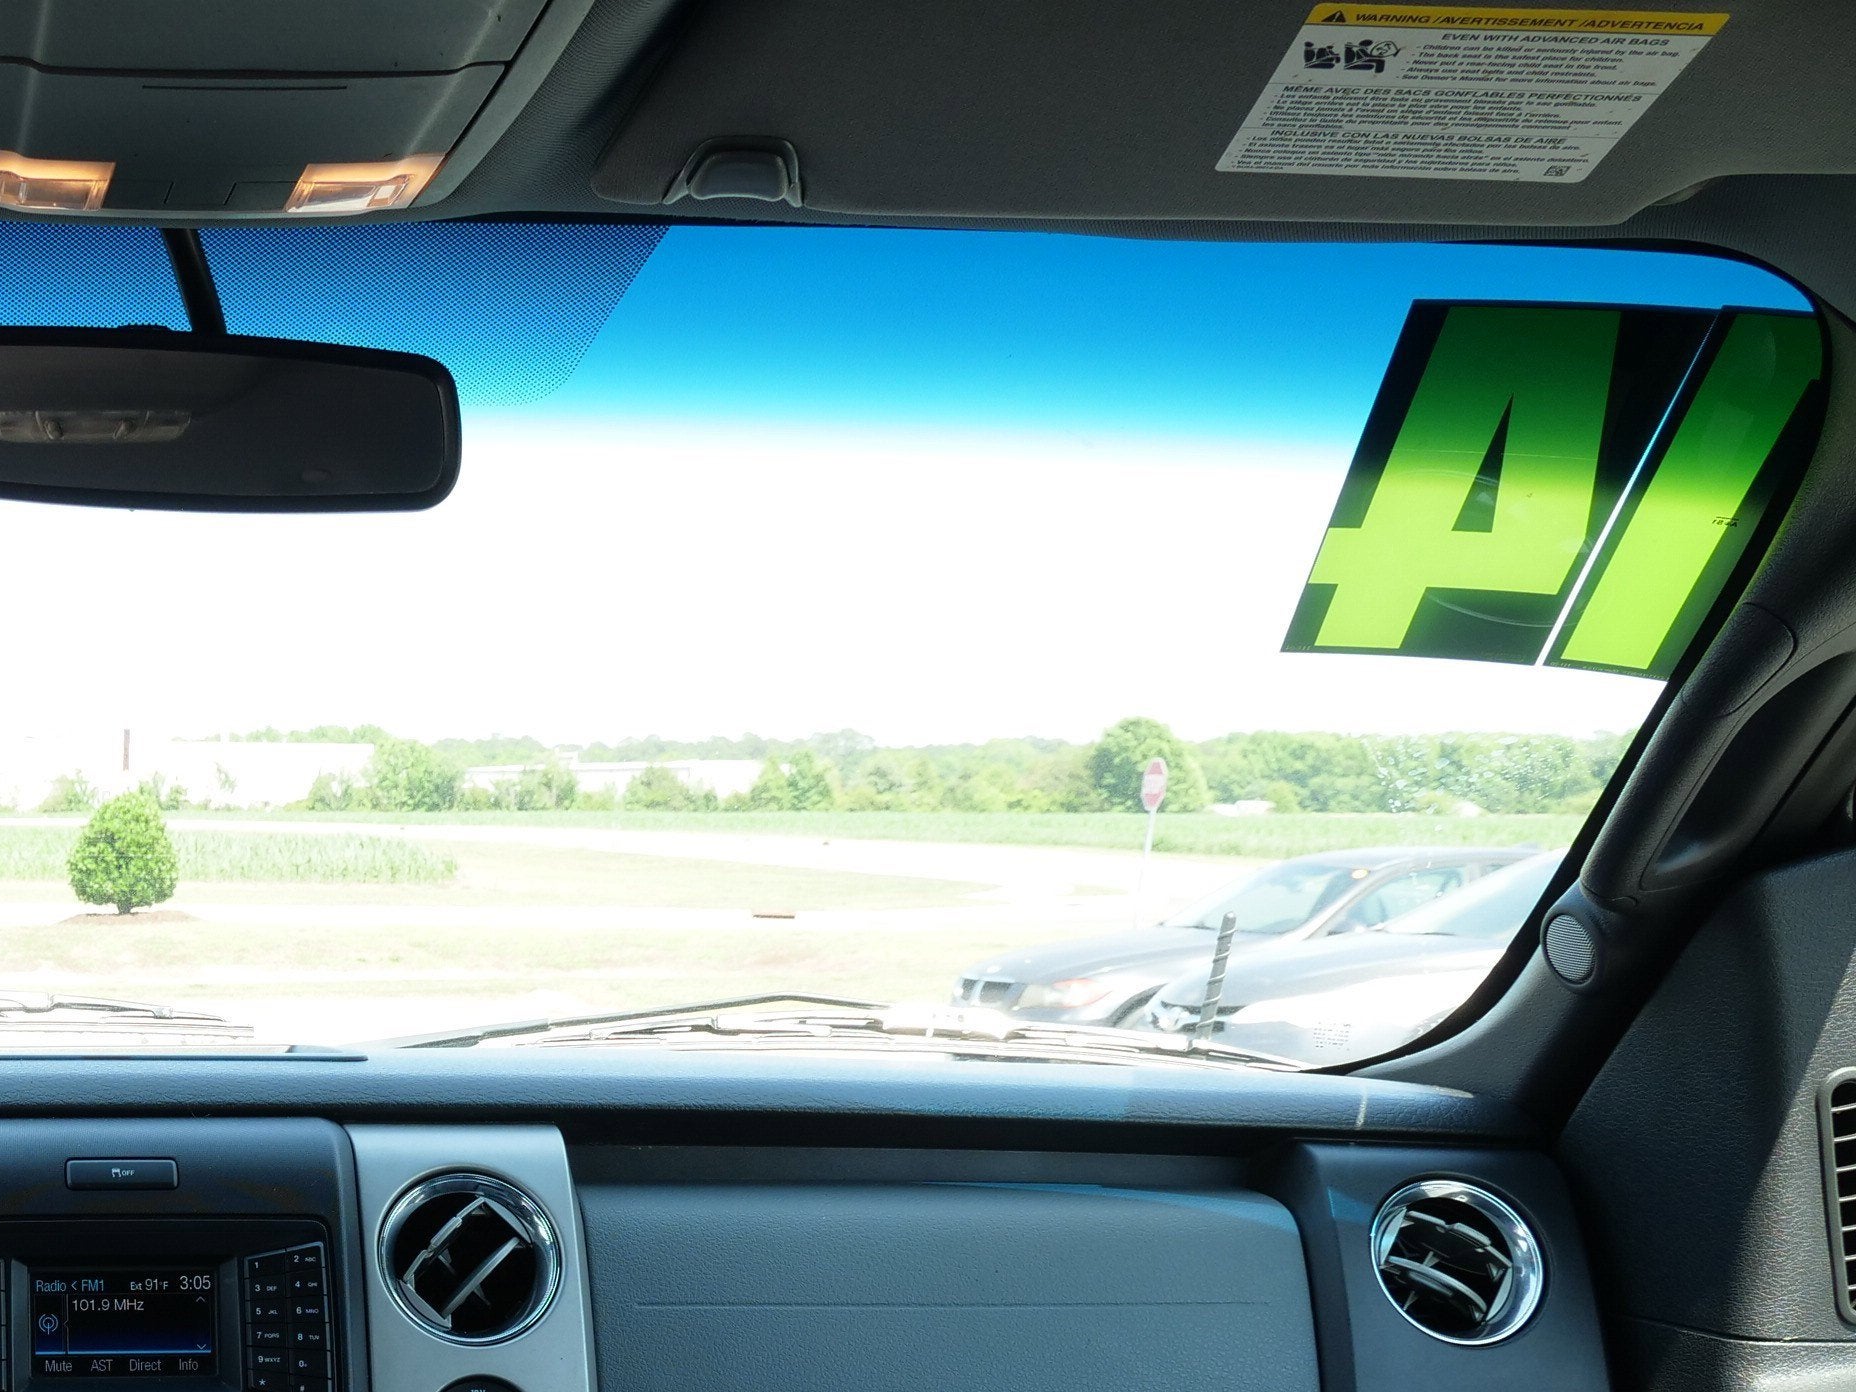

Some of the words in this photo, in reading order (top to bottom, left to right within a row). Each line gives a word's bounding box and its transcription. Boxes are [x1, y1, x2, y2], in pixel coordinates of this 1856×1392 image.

[1355, 14, 1430, 23] WARNING
[293, 1255, 299, 1263] 2
[36, 1279, 67, 1292] Radio
[81, 1279, 104, 1292] FM1
[130, 1281, 142, 1291] Ext
[179, 1275, 211, 1290] 3:05
[255, 1284, 261, 1292] 3
[72, 1299, 110, 1311] 101.9
[113, 1299, 144, 1311] MHz
[296, 1306, 302, 1314] 6
[256, 1307, 261, 1315] 5
[297, 1333, 303, 1341] 8
[258, 1355, 263, 1363] 9
[45, 1359, 72, 1372] Mute
[90, 1359, 113, 1372] AST
[129, 1359, 161, 1371] Direct
[179, 1358, 198, 1371] Info
